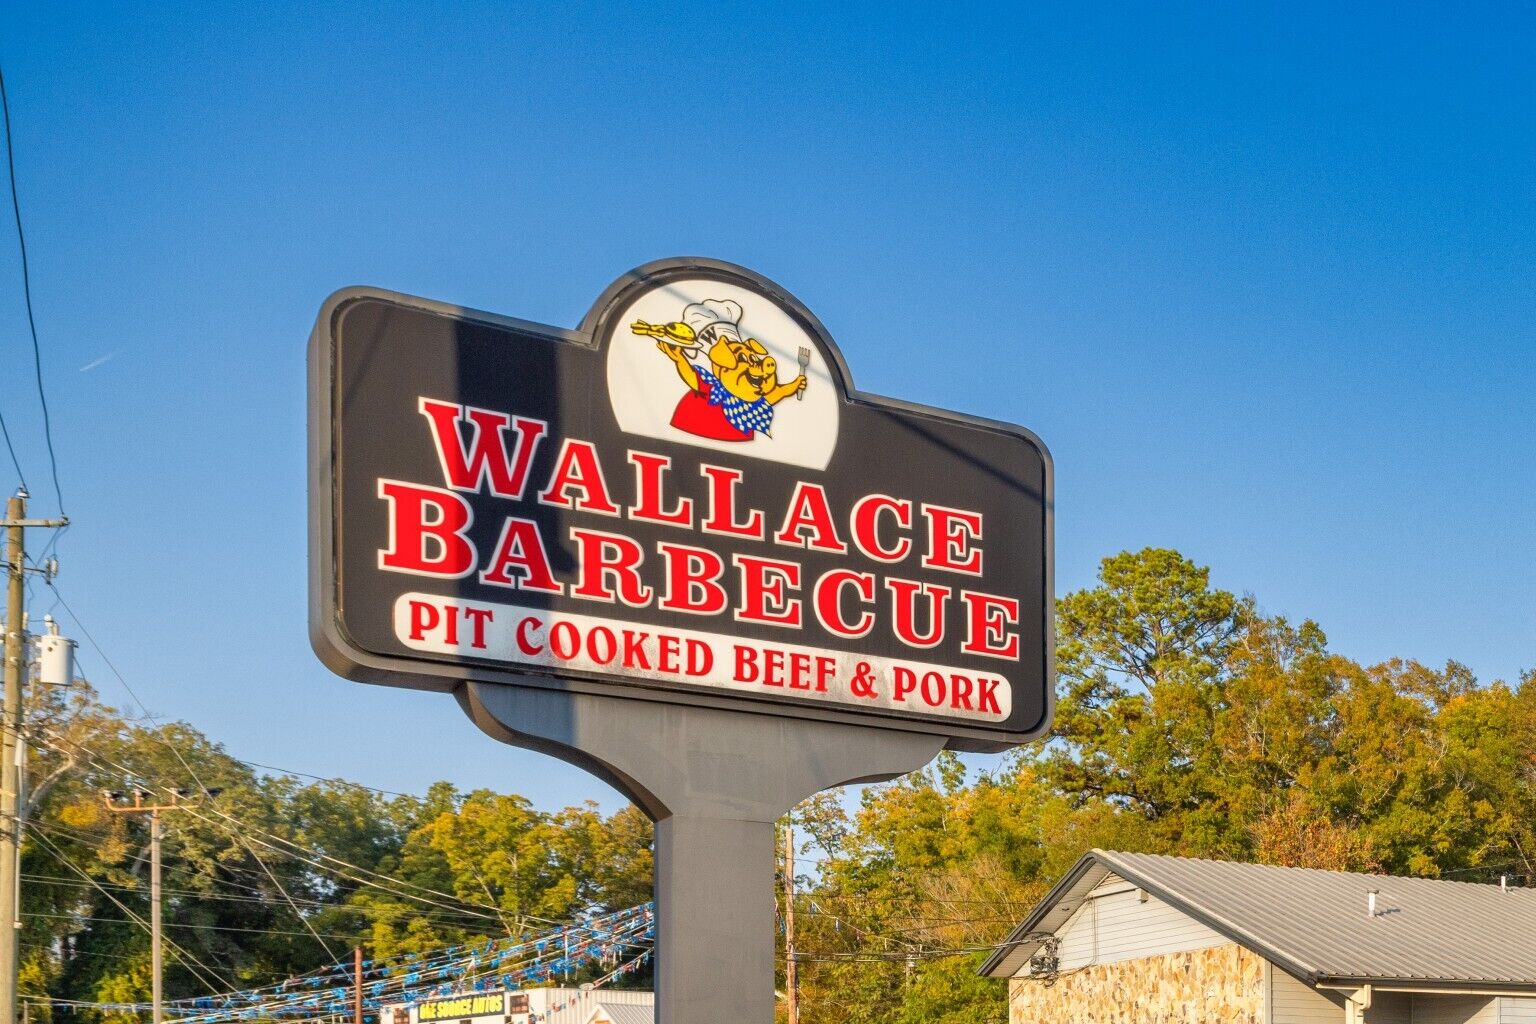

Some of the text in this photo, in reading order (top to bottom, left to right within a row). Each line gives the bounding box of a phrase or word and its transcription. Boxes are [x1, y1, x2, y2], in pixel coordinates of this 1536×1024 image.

[419, 397, 984, 577] WALLACE
[377, 477, 1021, 662] BARBECUE
[408, 600, 1003, 715] PIT COOKED BEEF & PORK
[472, 995, 503, 1014] AUTOS
